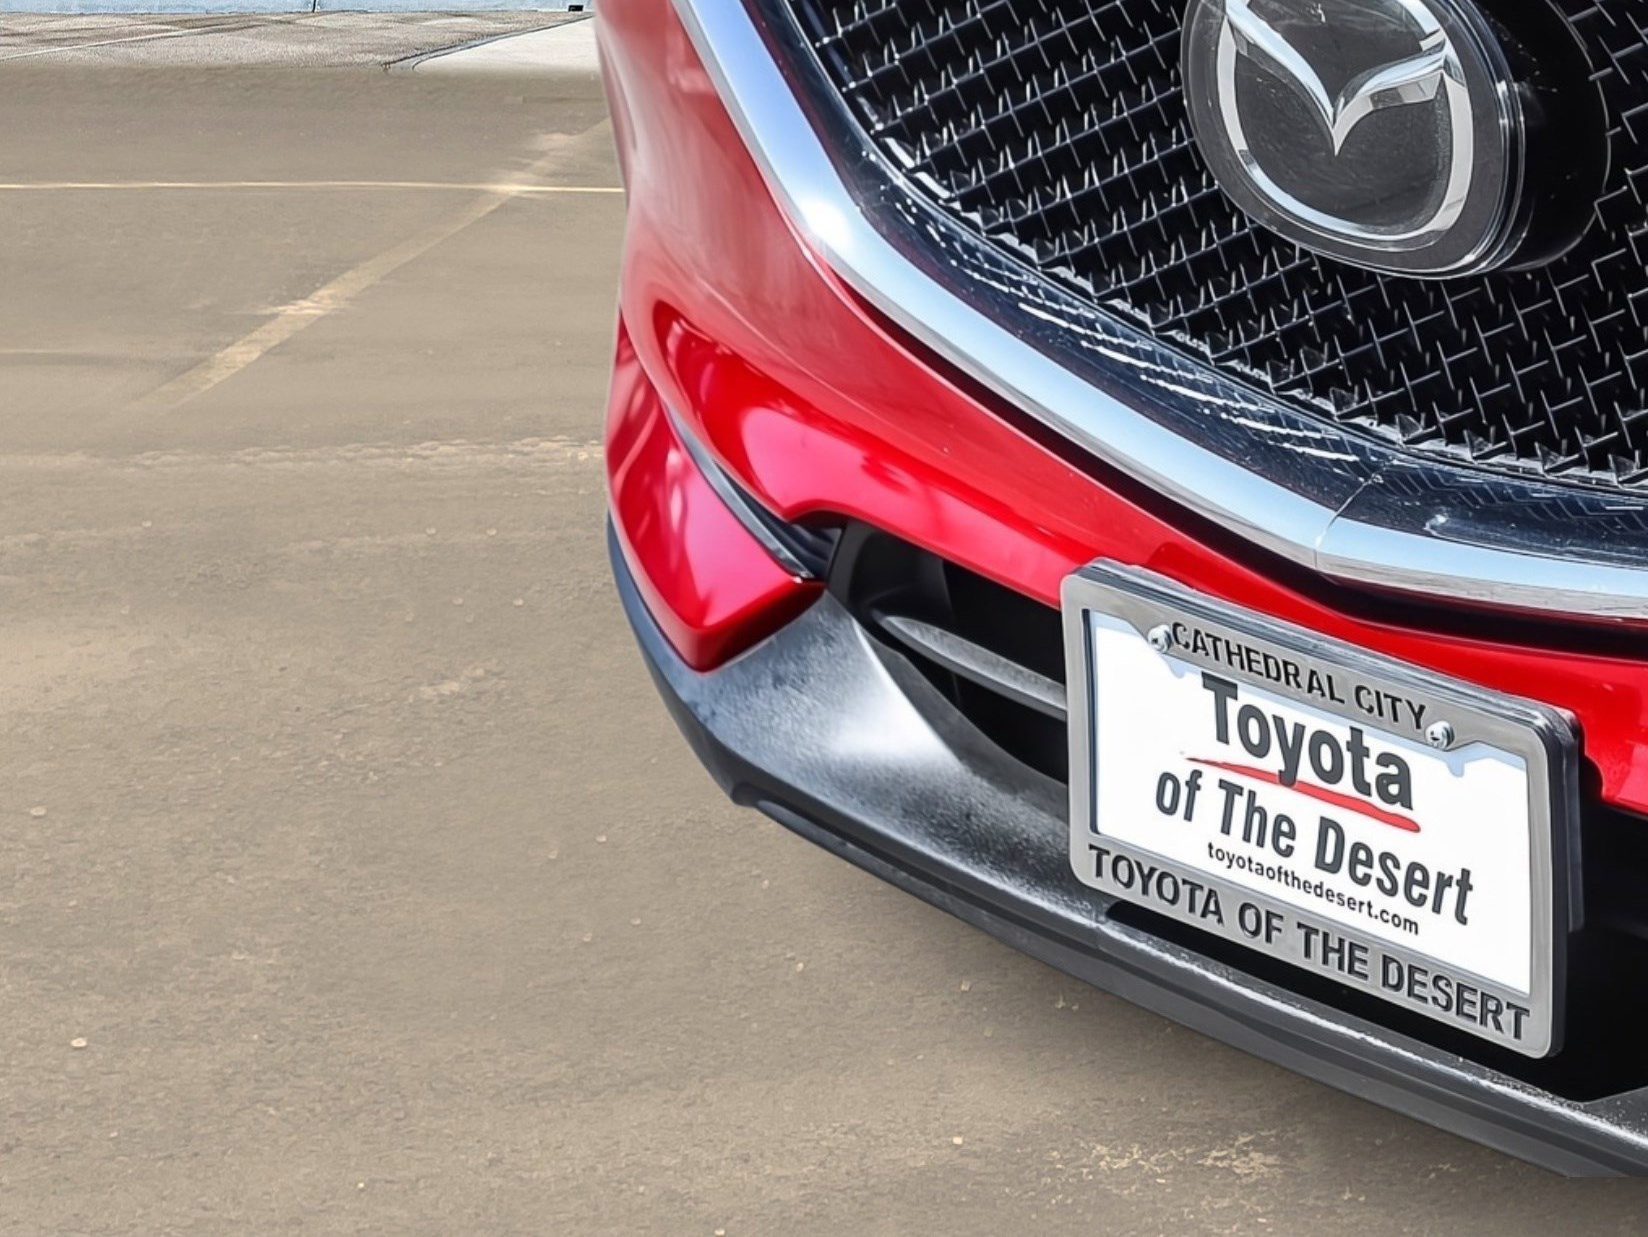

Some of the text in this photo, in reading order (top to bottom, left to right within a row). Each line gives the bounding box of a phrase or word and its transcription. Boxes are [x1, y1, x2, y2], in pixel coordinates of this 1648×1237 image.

[1171, 621, 1428, 732] CATHEDRAL CITY
[1201, 671, 1415, 812] Toyota
[1155, 770, 1475, 926] of The Desert
[1207, 841, 1420, 937] toyotaofthedesert.com
[1088, 843, 1532, 1041] TOYOTA OF THE DESERT
